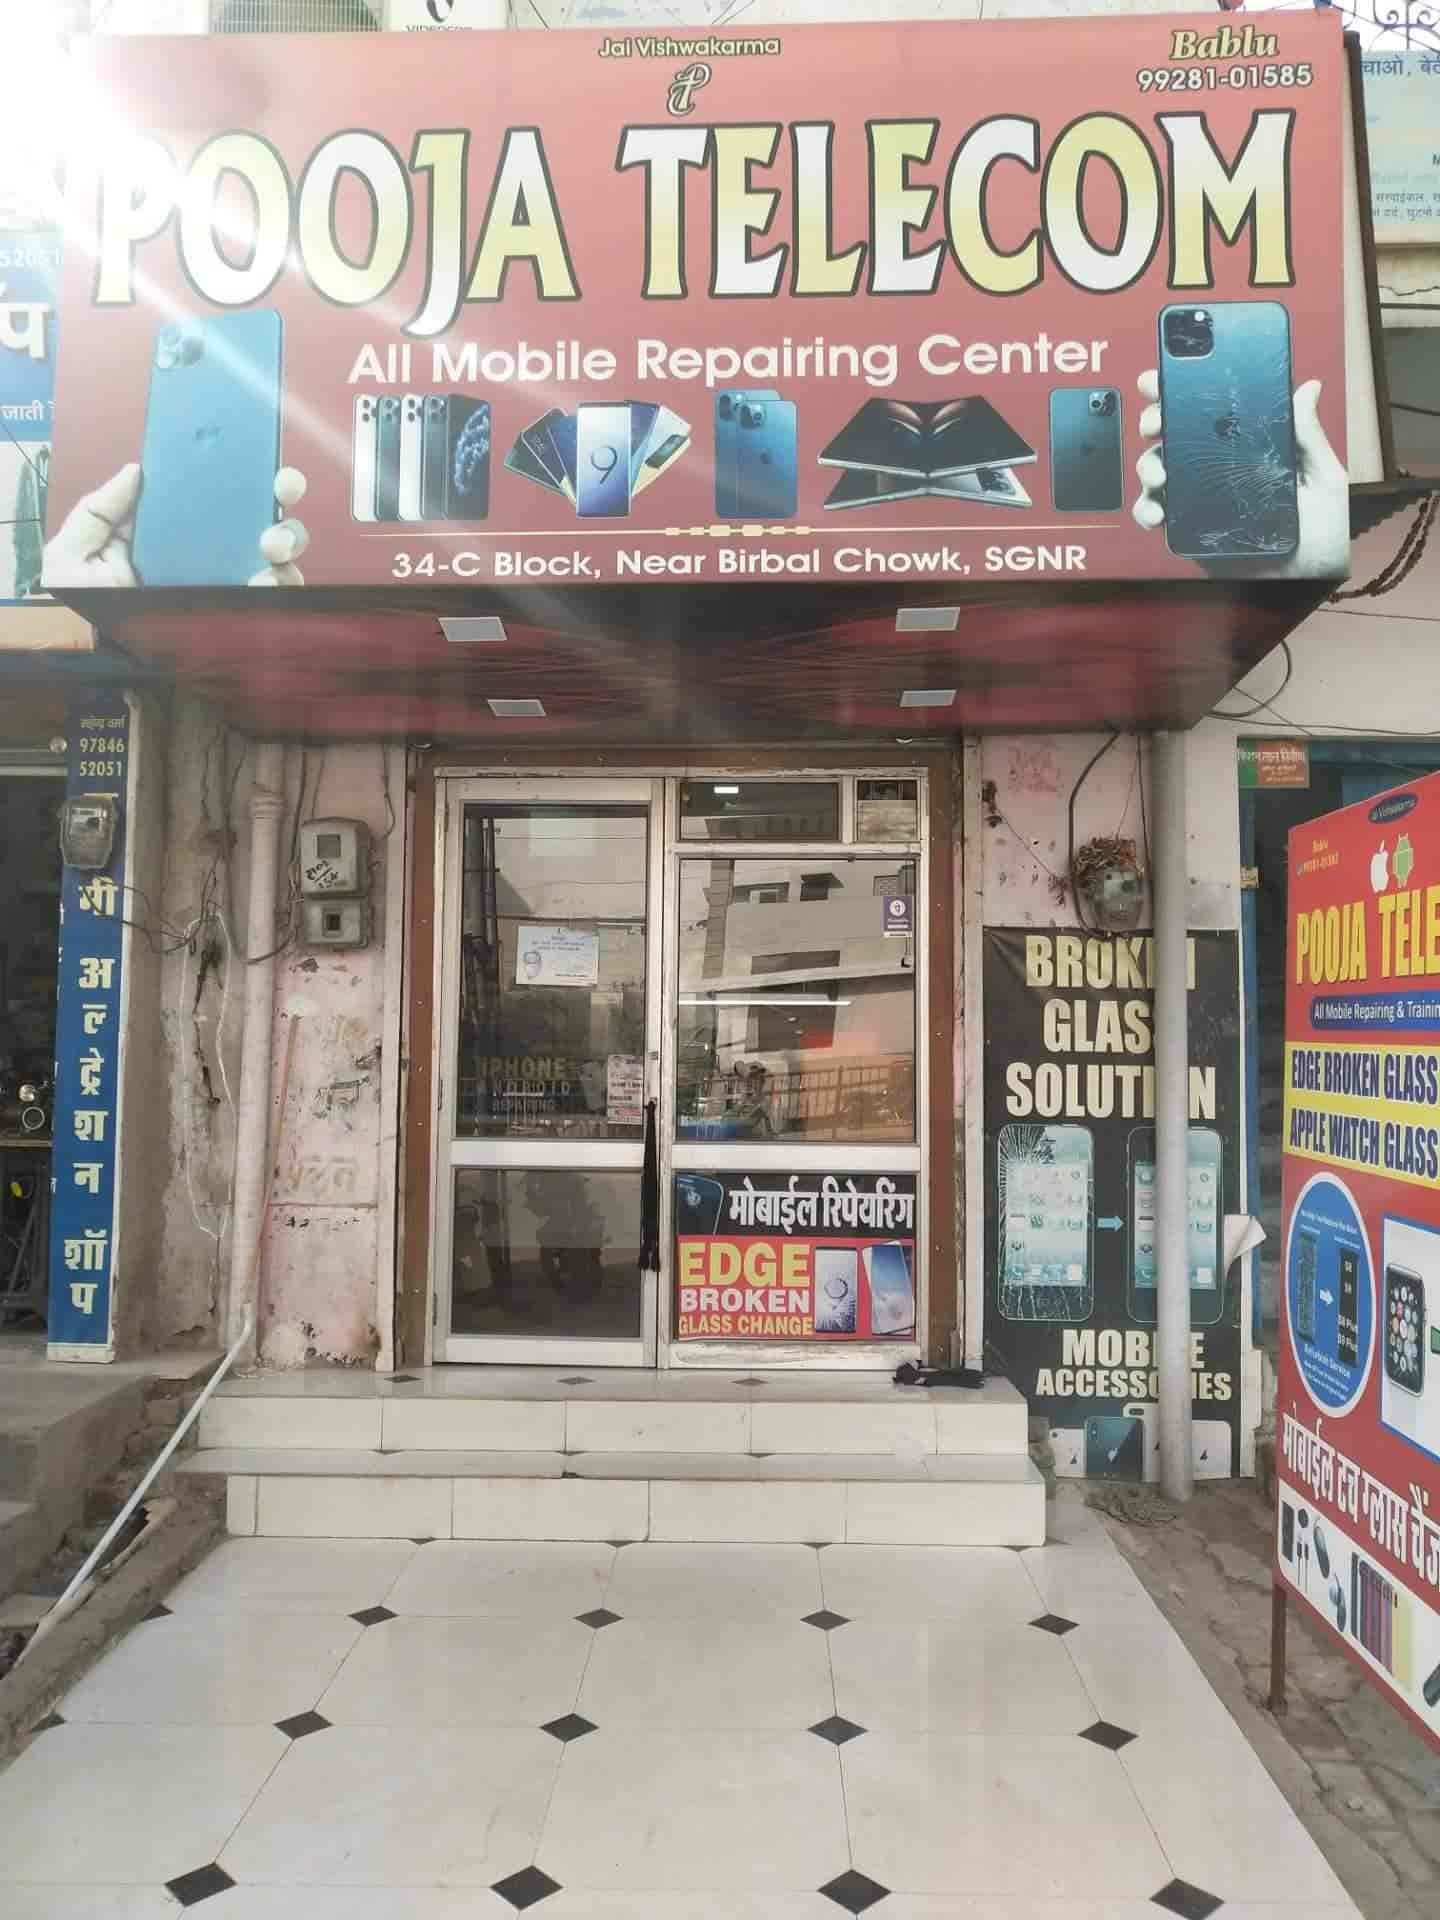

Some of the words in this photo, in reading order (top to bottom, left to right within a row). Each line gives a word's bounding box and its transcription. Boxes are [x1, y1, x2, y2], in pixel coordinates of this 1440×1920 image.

[599, 38, 633, 57] Jai
[638, 36, 781, 57] Vishwakarma
[1169, 25, 1280, 61] Bablu
[1137, 64, 1314, 92] 99281-01585
[92, 126, 582, 338] POOJA
[614, 106, 1297, 298] TELECOM
[347, 343, 411, 383] All
[431, 340, 617, 383] Mobile
[636, 336, 898, 387] Repairing
[918, 332, 1109, 376] Center
[391, 552, 481, 577] 34-C
[494, 551, 601, 579] Block,
[616, 550, 707, 576] Near
[718, 548, 820, 573] Birbal
[833, 546, 971, 576] Chowk,
[984, 545, 1087, 571] SGNR
[79, 738, 125, 753] 97846
[79, 761, 122, 776] 52051
[1025, 934, 1196, 990] BROK
[1295, 902, 1367, 985] POOJA
[1043, 998, 1152, 1055] GLAS
[1314, 1005, 1324, 1020] All
[1326, 1005, 1352, 1021] Mobile
[1354, 1004, 1394, 1023] Repairing
[1396, 1004, 1406, 1019] &
[1006, 1062, 1216, 1120] SOLUTIN
[1292, 1050, 1321, 1092] EDGE
[1324, 1052, 1380, 1098] BROKEN
[1384, 1053, 1438, 1105] GLASS
[1290, 1107, 1325, 1153] APPLE
[1328, 1113, 1380, 1167] WATCH
[1384, 1121, 1438, 1178] GLASS
[728, 1175, 818, 1235] मोबाईल
[822, 1175, 914, 1230] रिपेयरिंग
[679, 1242, 811, 1287] EDGE
[680, 1288, 810, 1313] BROKEN
[678, 1316, 733, 1336] GLASS
[737, 1315, 813, 1337] CHANGE
[1283, 1401, 1335, 1503] मोबाईल
